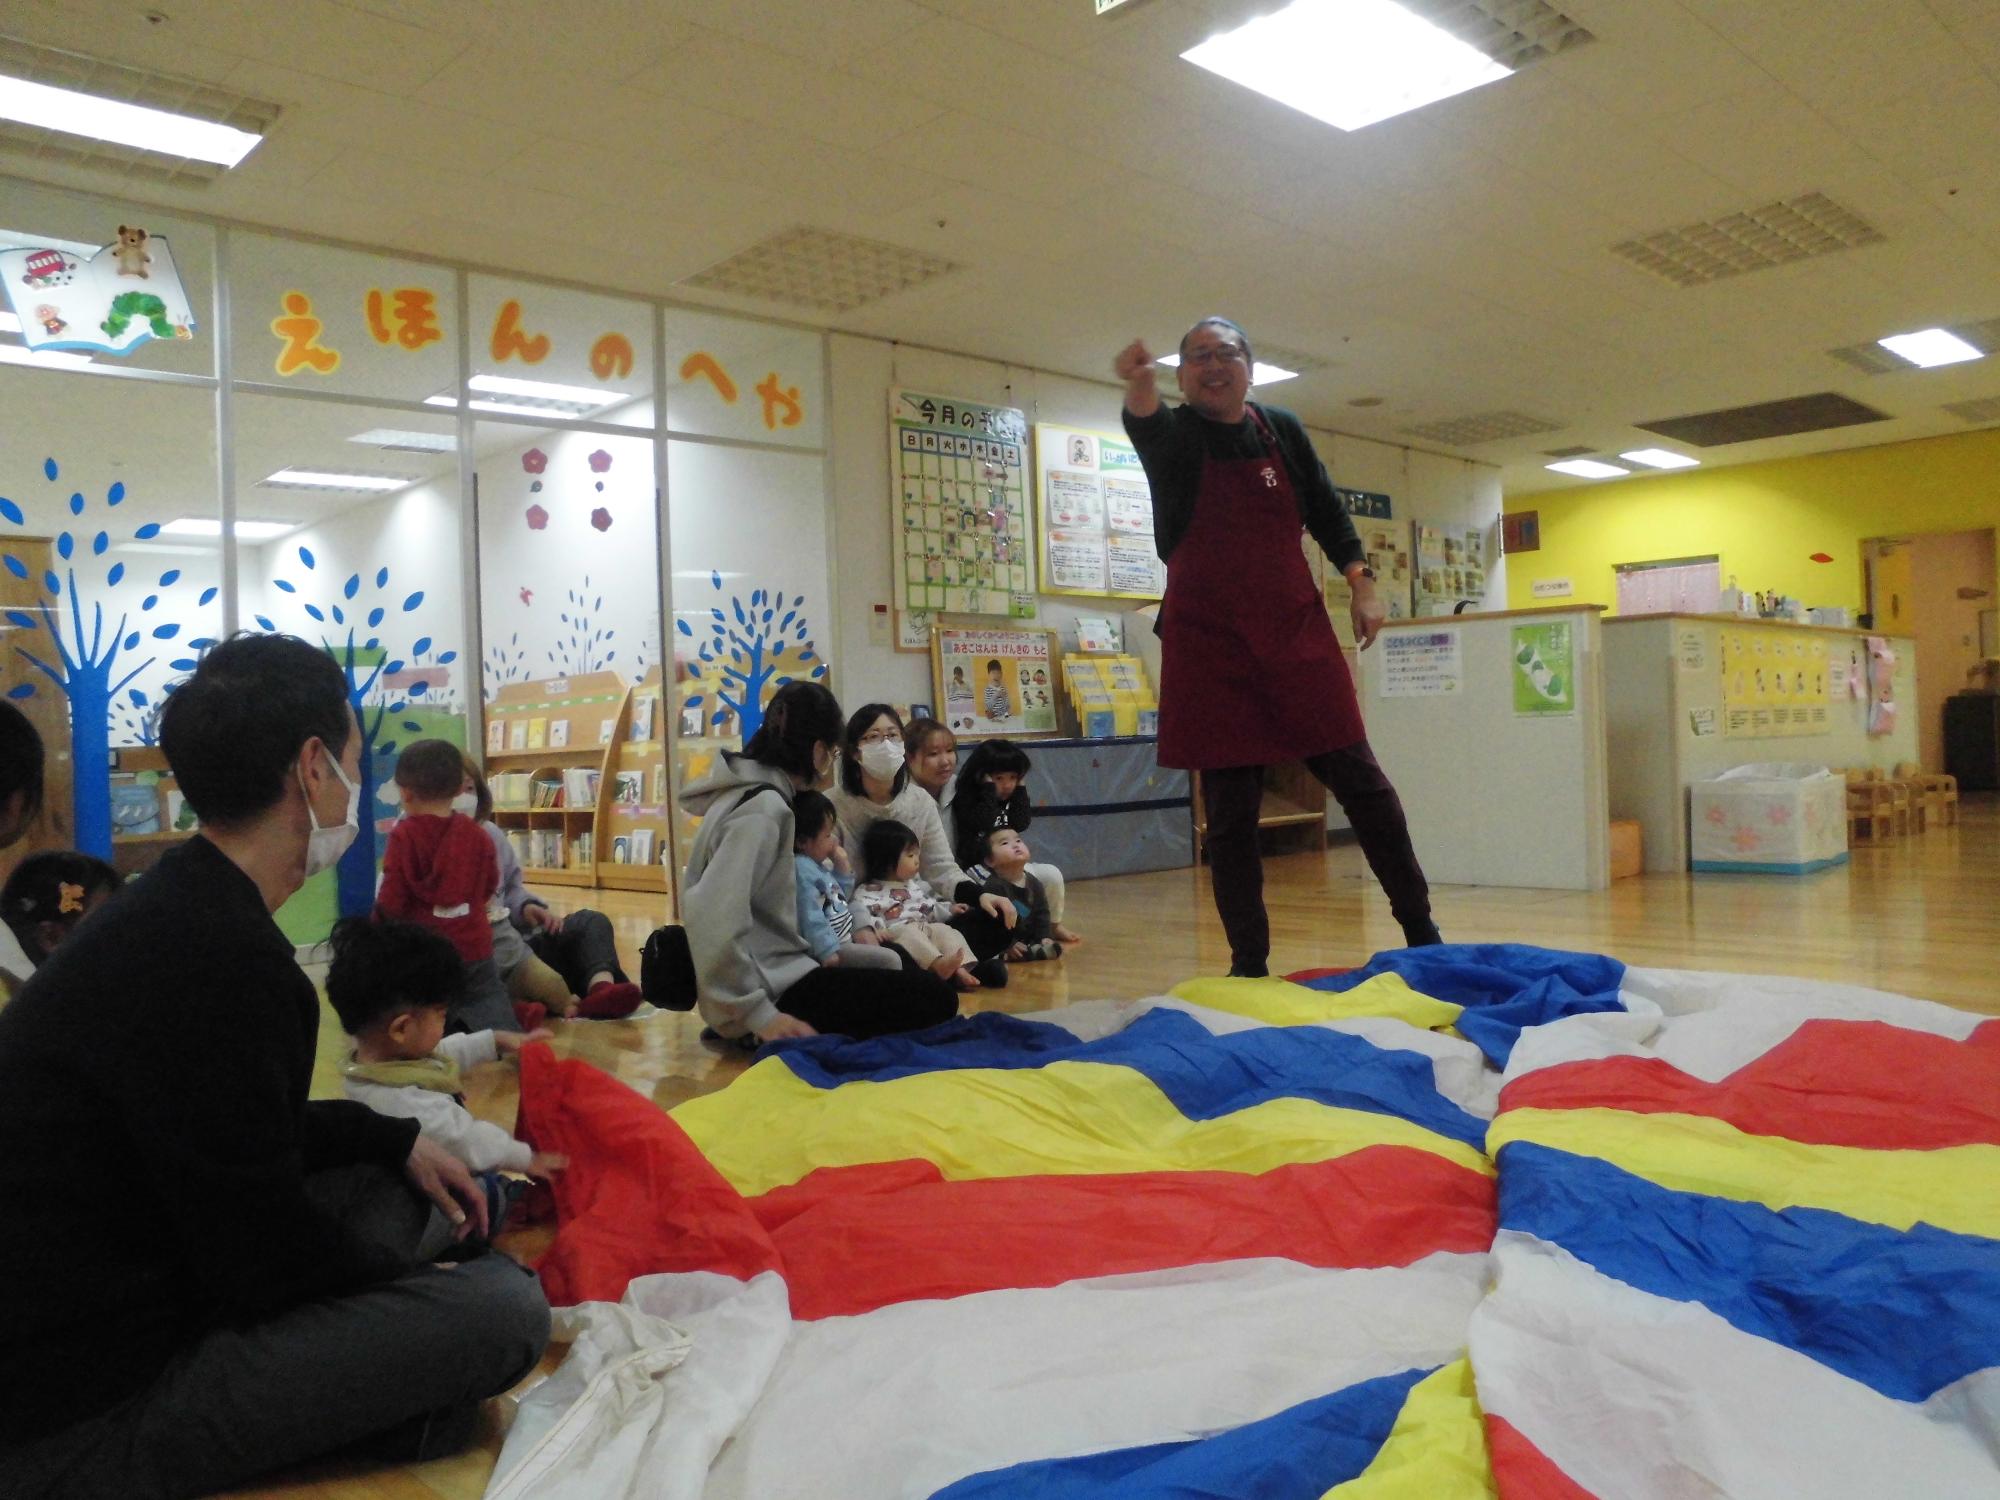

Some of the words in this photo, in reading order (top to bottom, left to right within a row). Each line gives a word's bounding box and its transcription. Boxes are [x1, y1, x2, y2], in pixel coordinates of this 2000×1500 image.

[271, 289, 803, 430] えほんのへや
[907, 435, 916, 446] 日
[926, 437, 934, 447] 月
[943, 440, 952, 450] 火
